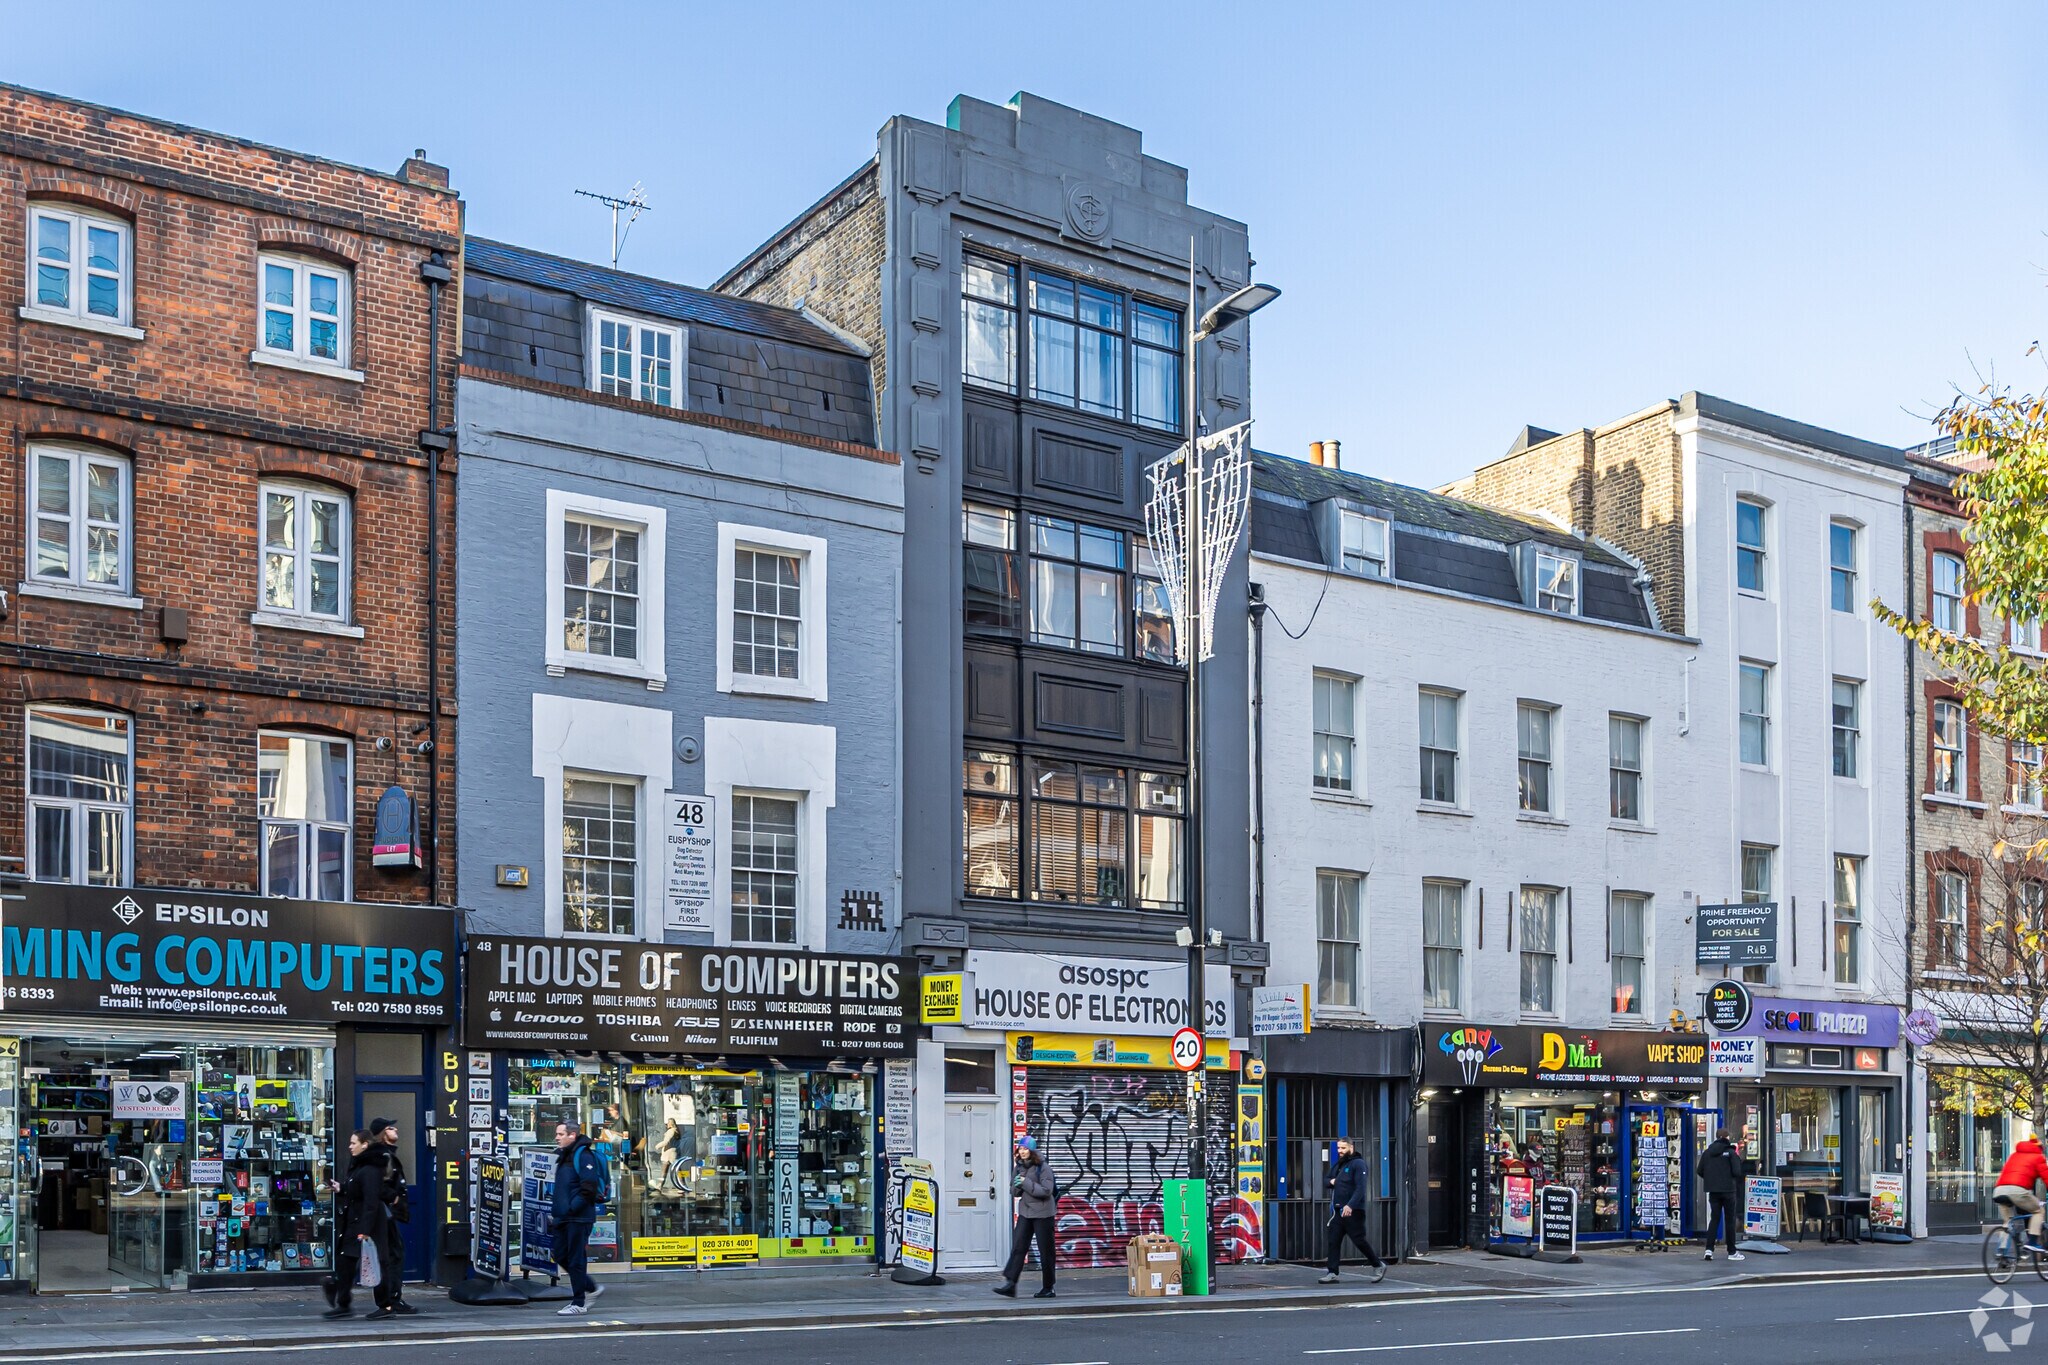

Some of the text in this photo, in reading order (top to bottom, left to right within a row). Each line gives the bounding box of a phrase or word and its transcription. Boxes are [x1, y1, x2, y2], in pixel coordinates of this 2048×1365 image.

[676, 804, 704, 824] 48
[668, 836, 711, 846] EUSPYSHOP
[674, 899, 704, 907] SPYSHOP
[155, 903, 268, 928] EPSILON
[1727, 907, 1771, 915] FREEHOLD
[1707, 917, 1766, 926] OPPORTUNITY
[1734, 928, 1760, 936] SALE
[477, 942, 492, 951] 48
[154, 934, 445, 996] COMPUTERS
[500, 944, 900, 1000] HOUSE OF COMPUTERS
[1059, 966, 1149, 993] asospc
[930, 980, 953, 992] MONEY
[20, 988, 54, 1000] 8393
[110, 983, 277, 1002] Web: www.epsilonpc.co.uk
[488, 991, 536, 1004] APPLE MAC
[1714, 988, 1724, 1000] D
[100, 995, 288, 1015] Email: info@epsilonpc.co.uk
[546, 993, 583, 1005] LAPTOPS
[593, 995, 657, 1008] MOBILE PHONES
[666, 998, 718, 1010] HEADPHONES
[925, 994, 958, 1006] EXCHANGE
[332, 1001, 444, 1016] Tel: 020 7580 8595
[727, 1001, 756, 1012] LENSES
[766, 1002, 832, 1014] VOICE RECORDERS
[840, 1004, 902, 1016] DIGITAL CAMERAS
[975, 988, 1226, 1026] HOUSE OF ELECTRONCS
[514, 1011, 876, 1033] lenovo TOSHIBA ASUS SENNHEISER RØDE
[1764, 1009, 1867, 1034] SEOUL PLAZA
[486, 1030, 588, 1041] WWW.HOUSEOFCOMPUTERS.CO.UK
[630, 1032, 669, 1043] Canon
[685, 1034, 716, 1044] Nikon
[730, 1035, 778, 1045] FUJIFILM
[1176, 1040, 1198, 1058] 20
[1538, 1032, 1603, 1070] D Mart
[1710, 1041, 1754, 1051] MONEY
[1648, 1044, 1704, 1064] VAPE SHOP
[1710, 1054, 1754, 1063] EXCHANGE
[1483, 1065, 1502, 1073] Bureau
[1644, 1124, 1656, 1134] £1
[482, 1164, 504, 1180] LAPTOP
[781, 1162, 792, 1238] CAMER
